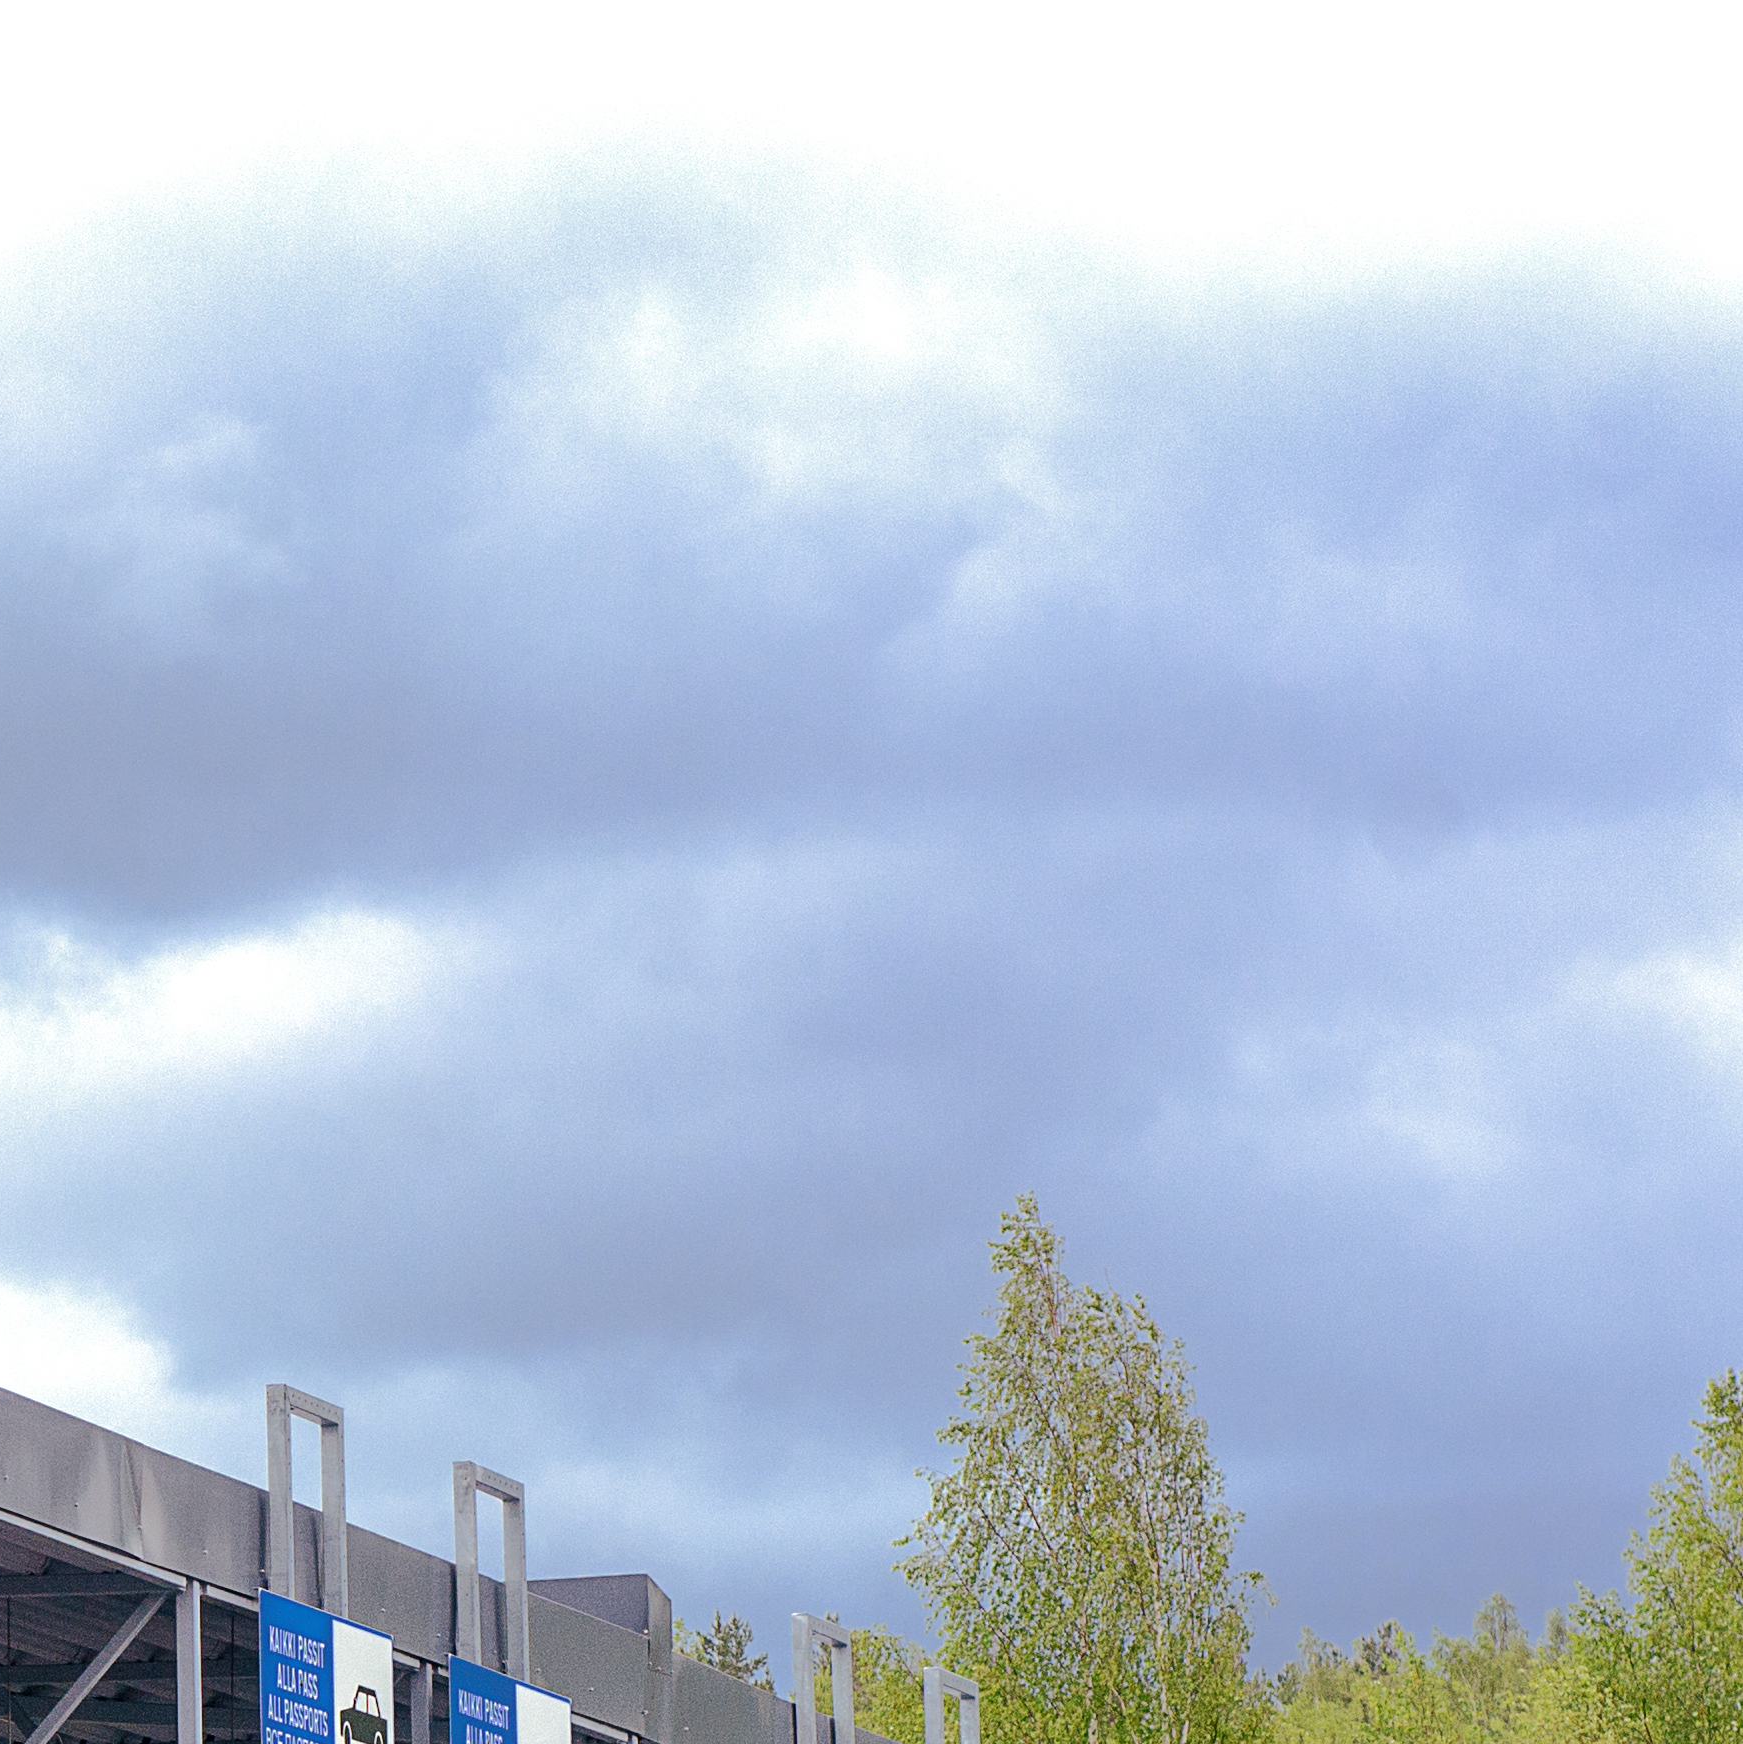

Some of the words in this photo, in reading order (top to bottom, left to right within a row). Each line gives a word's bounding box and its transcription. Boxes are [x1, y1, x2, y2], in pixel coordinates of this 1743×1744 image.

[269, 1625, 295, 1660] KAIKKI
[298, 1635, 324, 1668] PASSIT
[277, 1663, 296, 1694] ALLA
[298, 1672, 318, 1700] PASS
[268, 1694, 282, 1724] ALL
[285, 1699, 328, 1737] PASSPORTS
[459, 1689, 482, 1721] KAIKKI
[485, 1699, 509, 1730] PASSIT
